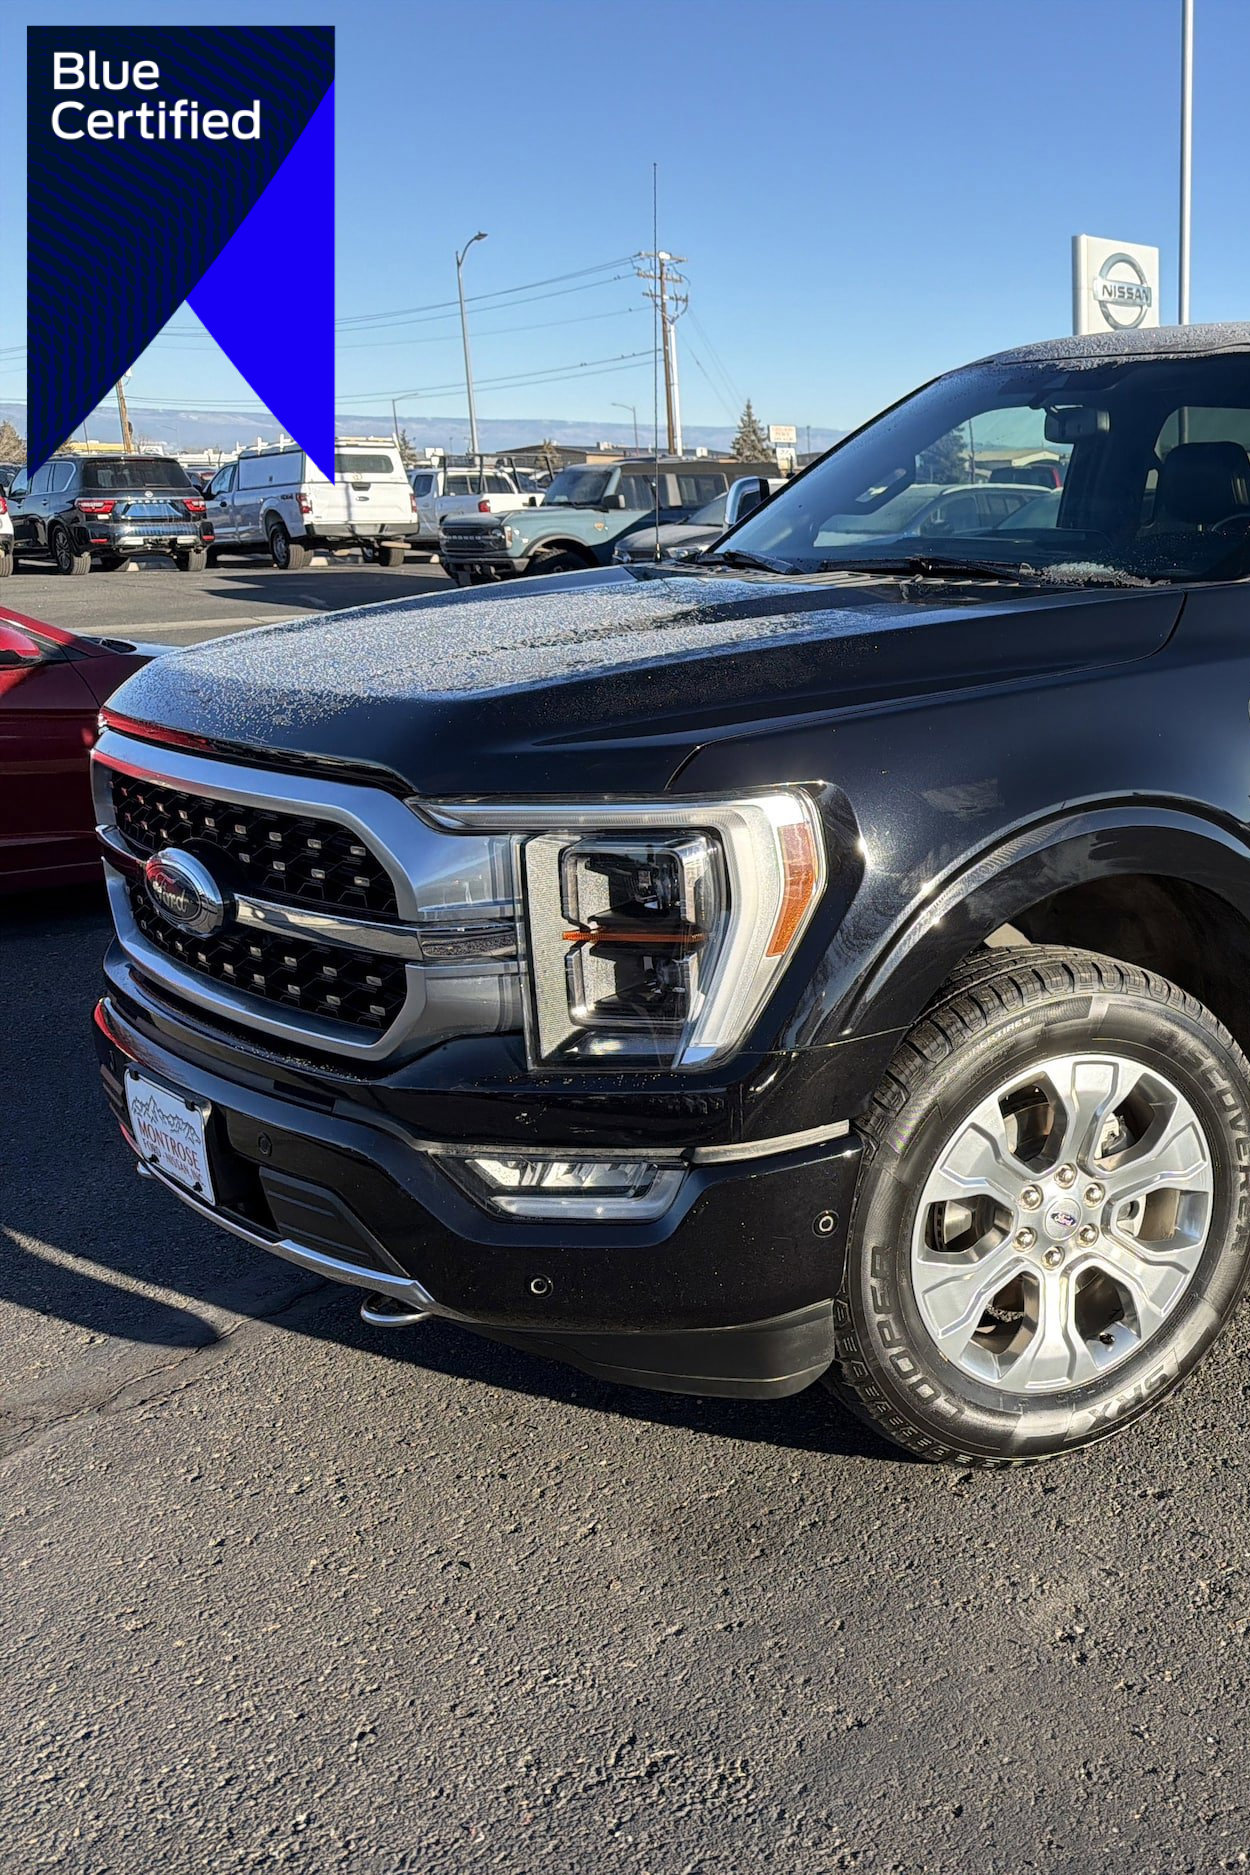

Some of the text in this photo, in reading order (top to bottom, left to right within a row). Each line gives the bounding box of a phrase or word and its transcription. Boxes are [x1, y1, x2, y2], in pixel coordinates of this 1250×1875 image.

[1102, 284, 1148, 303] NISSAN
[153, 871, 188, 913] Ford
[137, 1117, 201, 1172] MONTROSE
[870, 1245, 967, 1423] COOPER
[1086, 1363, 1170, 1433] SRX
